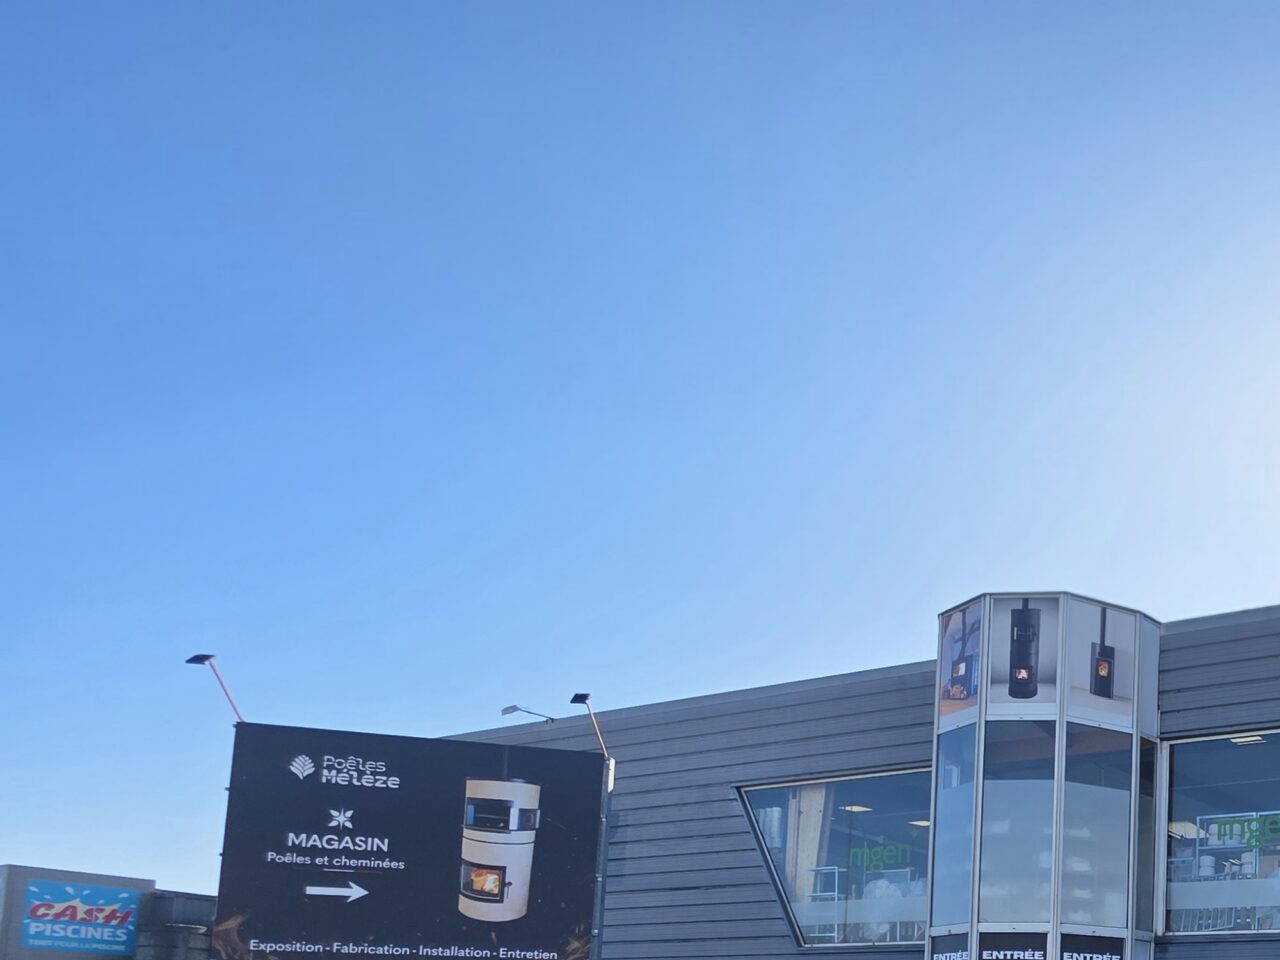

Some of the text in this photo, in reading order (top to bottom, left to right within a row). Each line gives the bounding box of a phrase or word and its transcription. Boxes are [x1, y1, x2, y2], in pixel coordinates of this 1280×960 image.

[323, 755, 387, 772] Poêles
[321, 768, 401, 789] Mélèze
[287, 832, 390, 853] MAGASIN
[266, 851, 406, 870] Poêles et cheminées
[28, 902, 133, 925] CASH
[29, 922, 128, 941] PISCINES
[249, 939, 324, 953] Exposition
[332, 942, 410, 956] Fabrication
[419, 945, 491, 958] Installation
[499, 947, 558, 960] Entretien
[982, 949, 1044, 960] ENTRÉE
